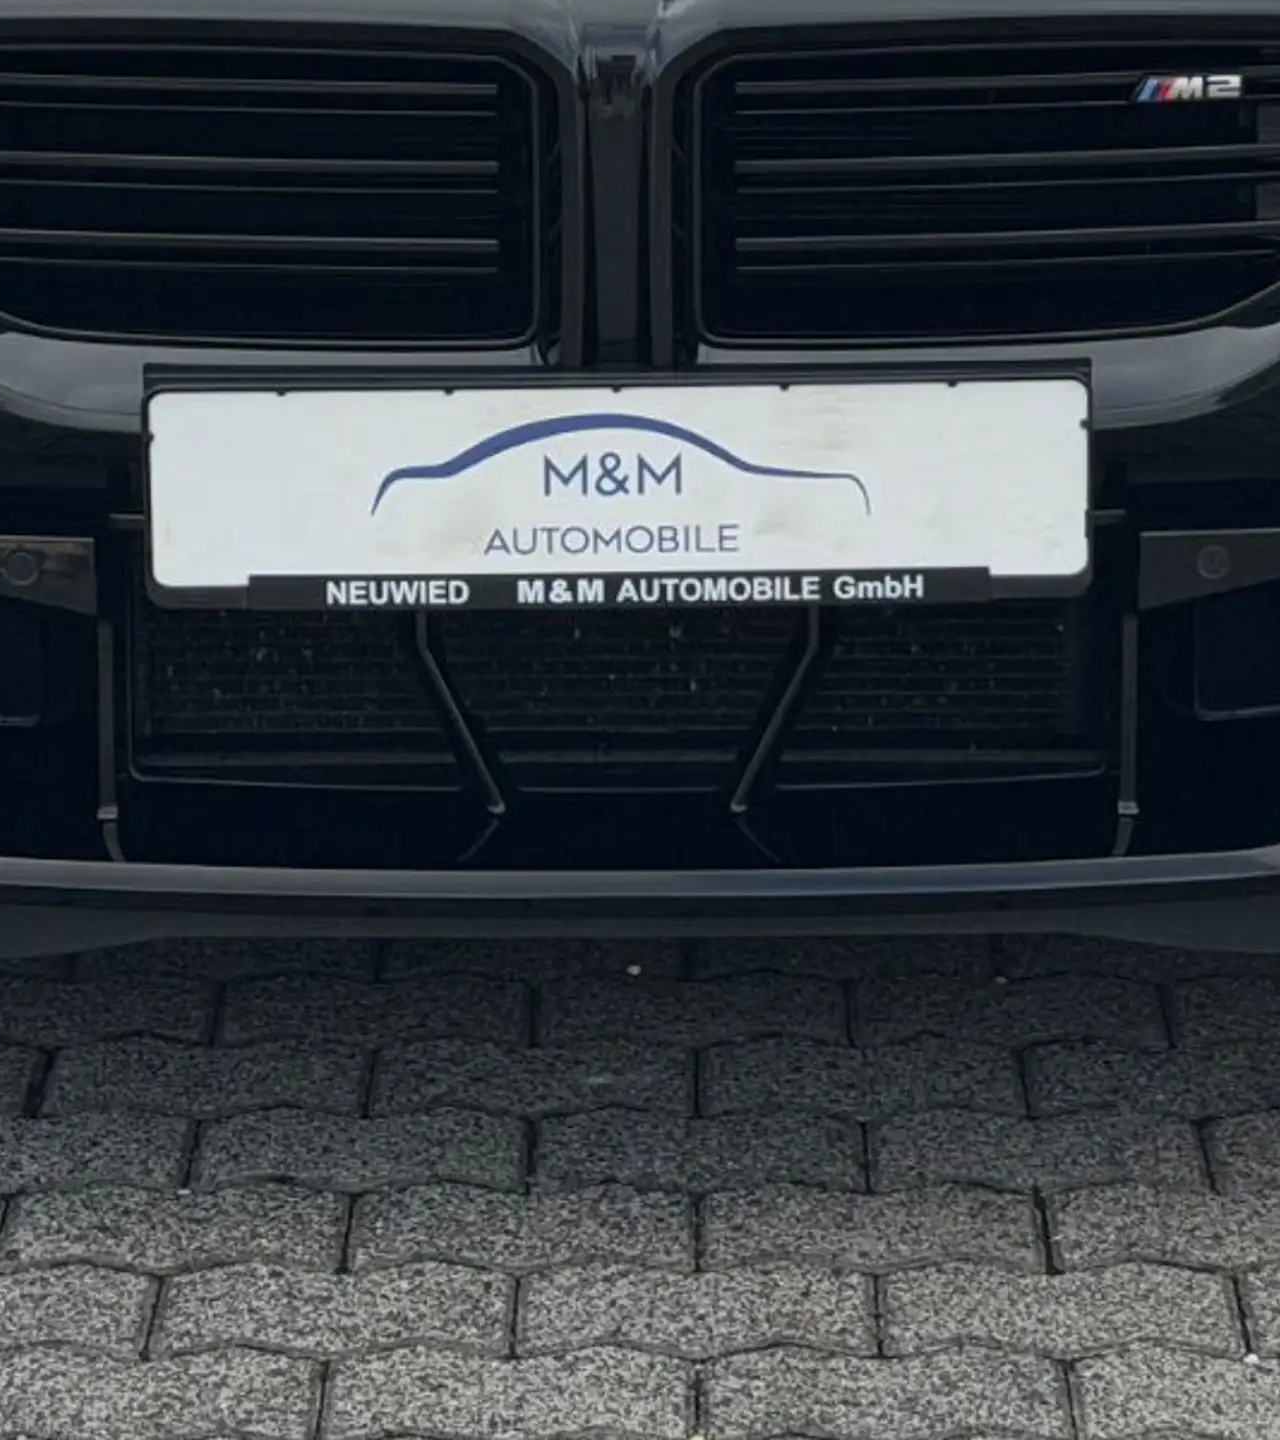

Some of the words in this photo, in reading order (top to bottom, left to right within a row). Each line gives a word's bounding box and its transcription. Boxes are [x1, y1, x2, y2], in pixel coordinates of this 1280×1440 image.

[543, 451, 684, 497] M&M
[483, 523, 740, 556] AUTOMOBILE
[325, 579, 470, 606] NEUWIED
[517, 578, 605, 604] M&M
[616, 576, 821, 603] AUTOMOBILE
[832, 573, 924, 599] GmbH
